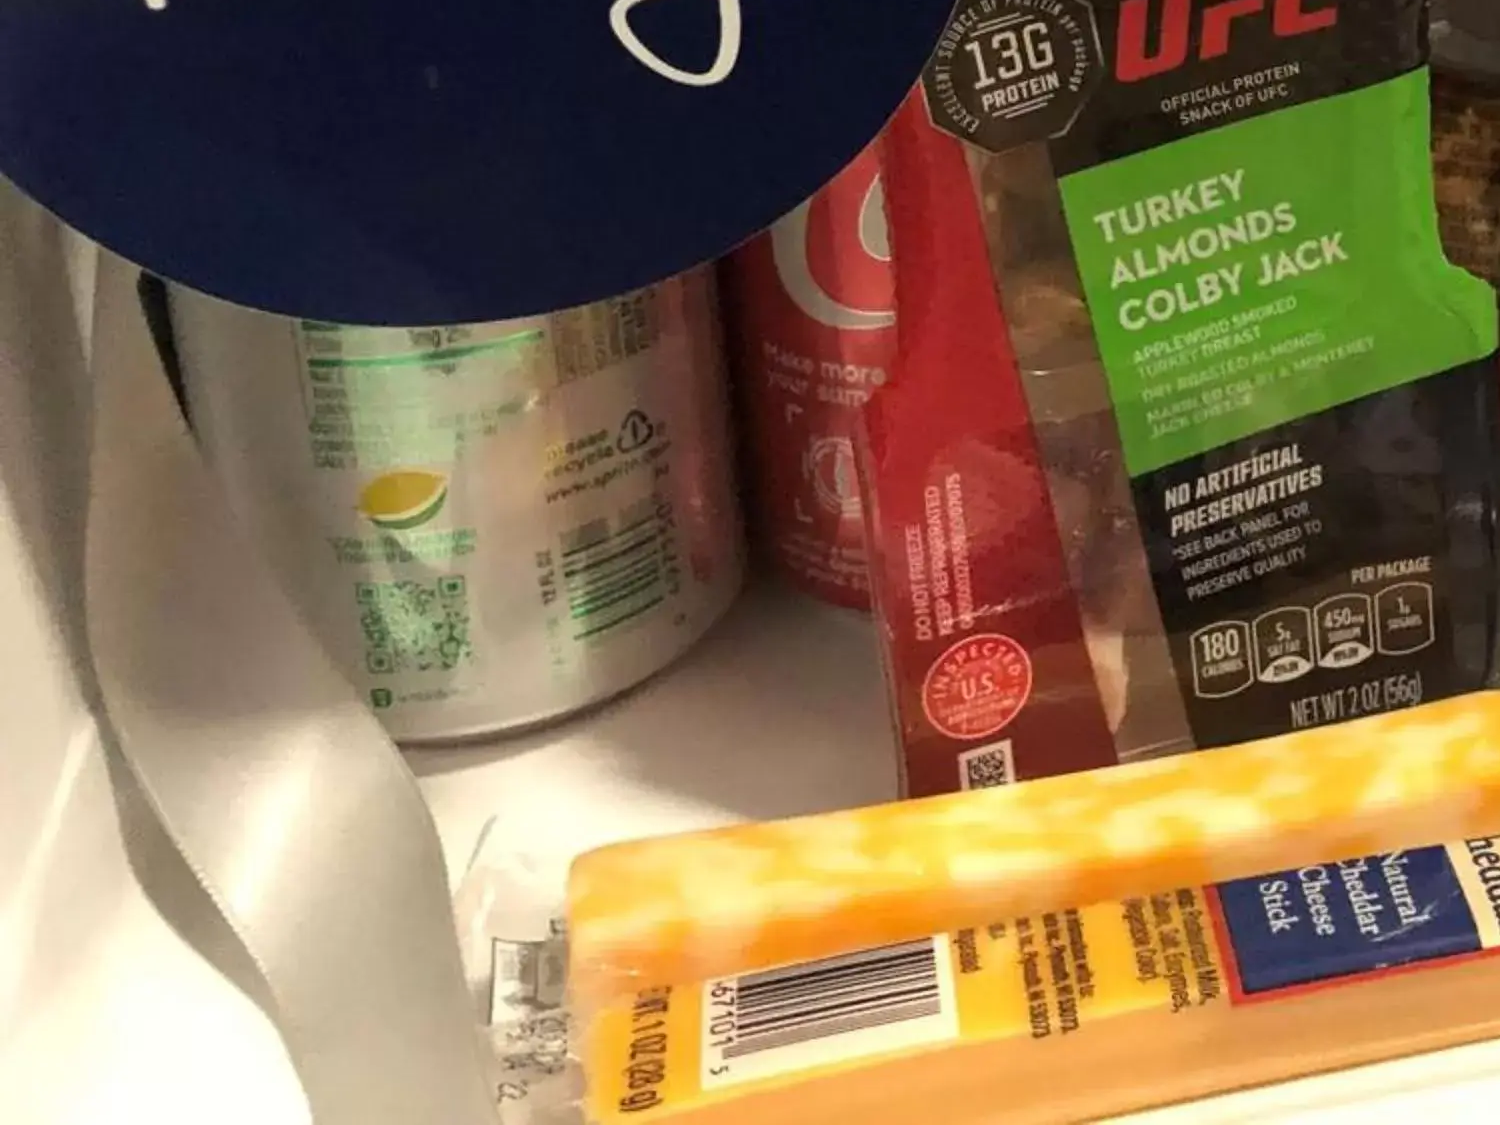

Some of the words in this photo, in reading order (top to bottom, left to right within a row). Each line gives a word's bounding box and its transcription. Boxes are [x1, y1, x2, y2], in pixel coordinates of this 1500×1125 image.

[963, 21, 1055, 90] 13G
[981, 71, 1061, 113] PROTEIN
[1160, 82, 1231, 113] OFFICIAL
[1233, 61, 1301, 92] PROTEIN
[1179, 100, 1233, 126] SNACK
[1235, 92, 1254, 109] OF
[1257, 83, 1289, 103] UFC
[1094, 169, 1247, 246] TURKEY
[1109, 202, 1298, 290] ALMONDS
[1118, 263, 1244, 332] COLBY
[1257, 232, 1350, 287] JACK
[1164, 482, 1191, 512] NO
[1195, 443, 1304, 500] ARTIFICIAL
[1170, 464, 1324, 538] PRESERVATIVES
[1181, 538, 1267, 581] INGREDIENTS
[1266, 525, 1301, 550] USED
[1304, 519, 1323, 536] TO
[1203, 526, 1240, 551] BACK
[1240, 511, 1283, 538] PANEL
[1282, 501, 1311, 522] FOR
[1186, 565, 1252, 602] PRESERVE
[1253, 544, 1307, 576] QUALITY
[1376, 556, 1433, 579] PACKAGE
[1200, 628, 1240, 664] 180
[1290, 694, 1321, 729] NET
[1321, 687, 1347, 721] WT
[1349, 688, 1360, 715] 2
[1361, 681, 1382, 711] OZ
[1259, 879, 1300, 934] Stick
[1298, 865, 1336, 937] Cheese
[1378, 851, 1432, 925] Natural
[709, 980, 736, 1048] 67101
[629, 1033, 668, 1060] OZ
[709, 1065, 730, 1076] 5
